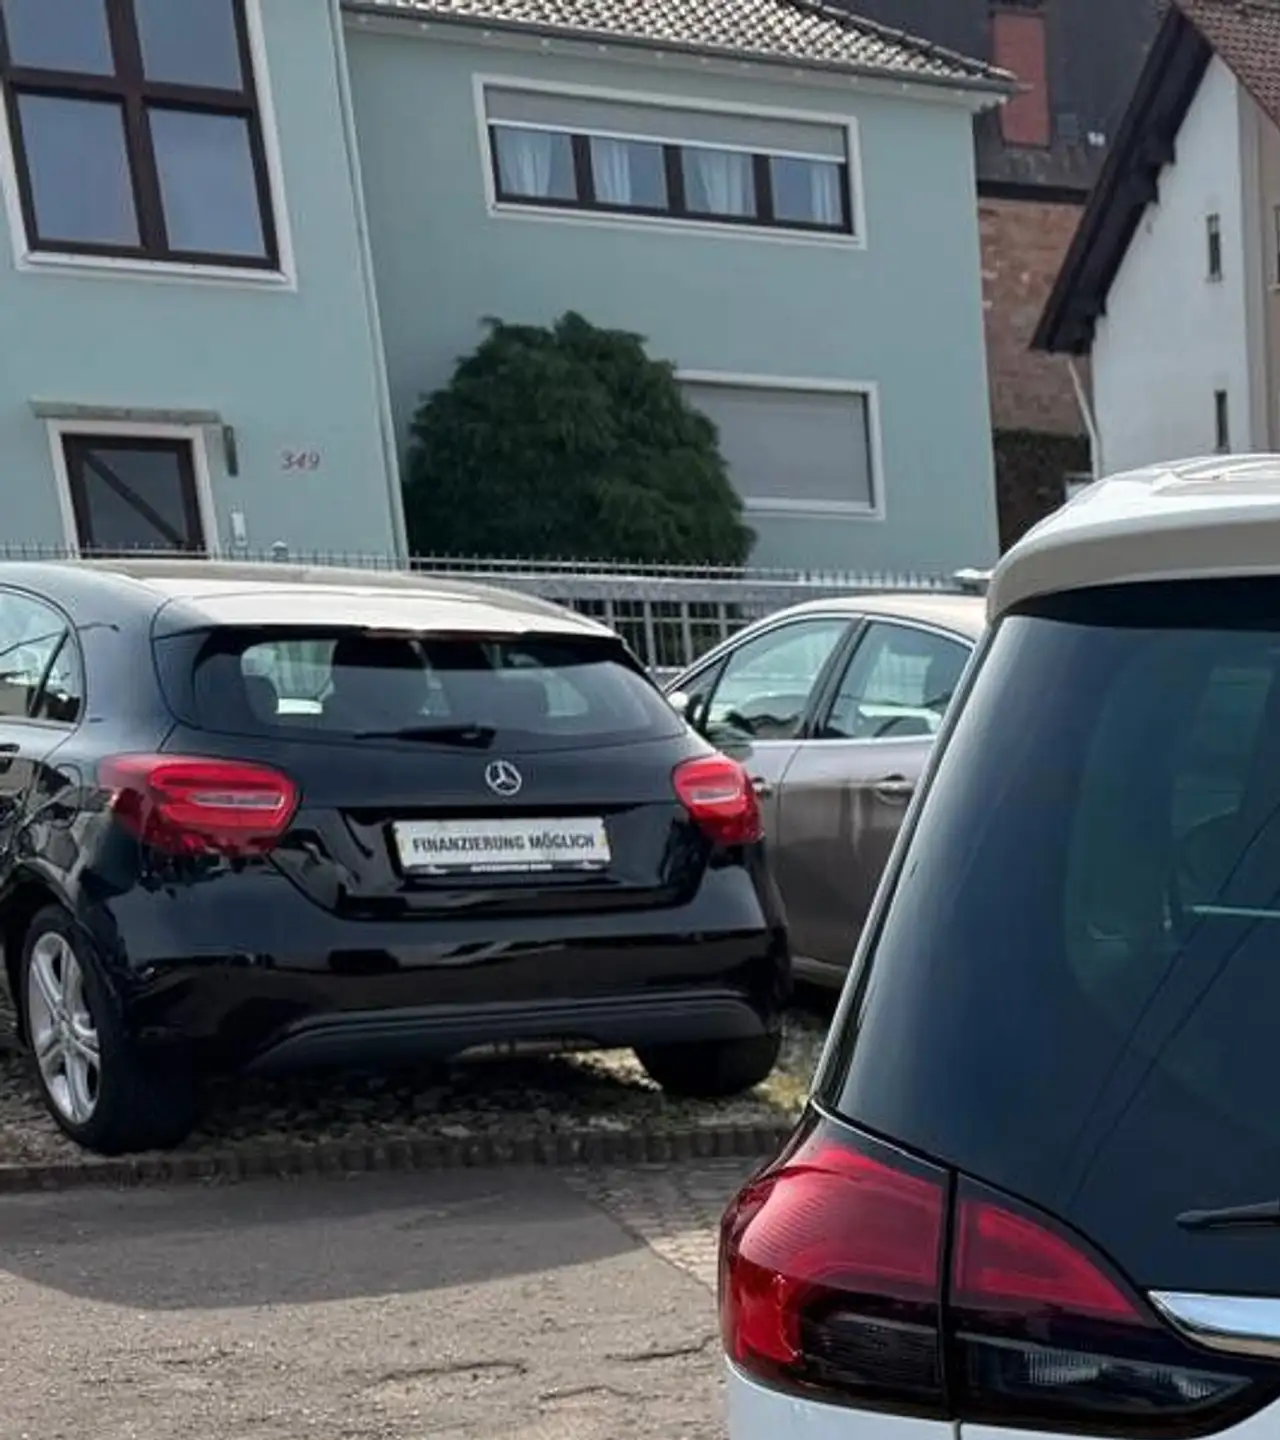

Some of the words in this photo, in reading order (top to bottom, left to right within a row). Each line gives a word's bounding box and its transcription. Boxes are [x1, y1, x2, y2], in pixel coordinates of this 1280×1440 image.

[279, 449, 321, 471] 349
[411, 835, 525, 854] FINANZIERUNG
[528, 832, 595, 850] MÖGLICH
